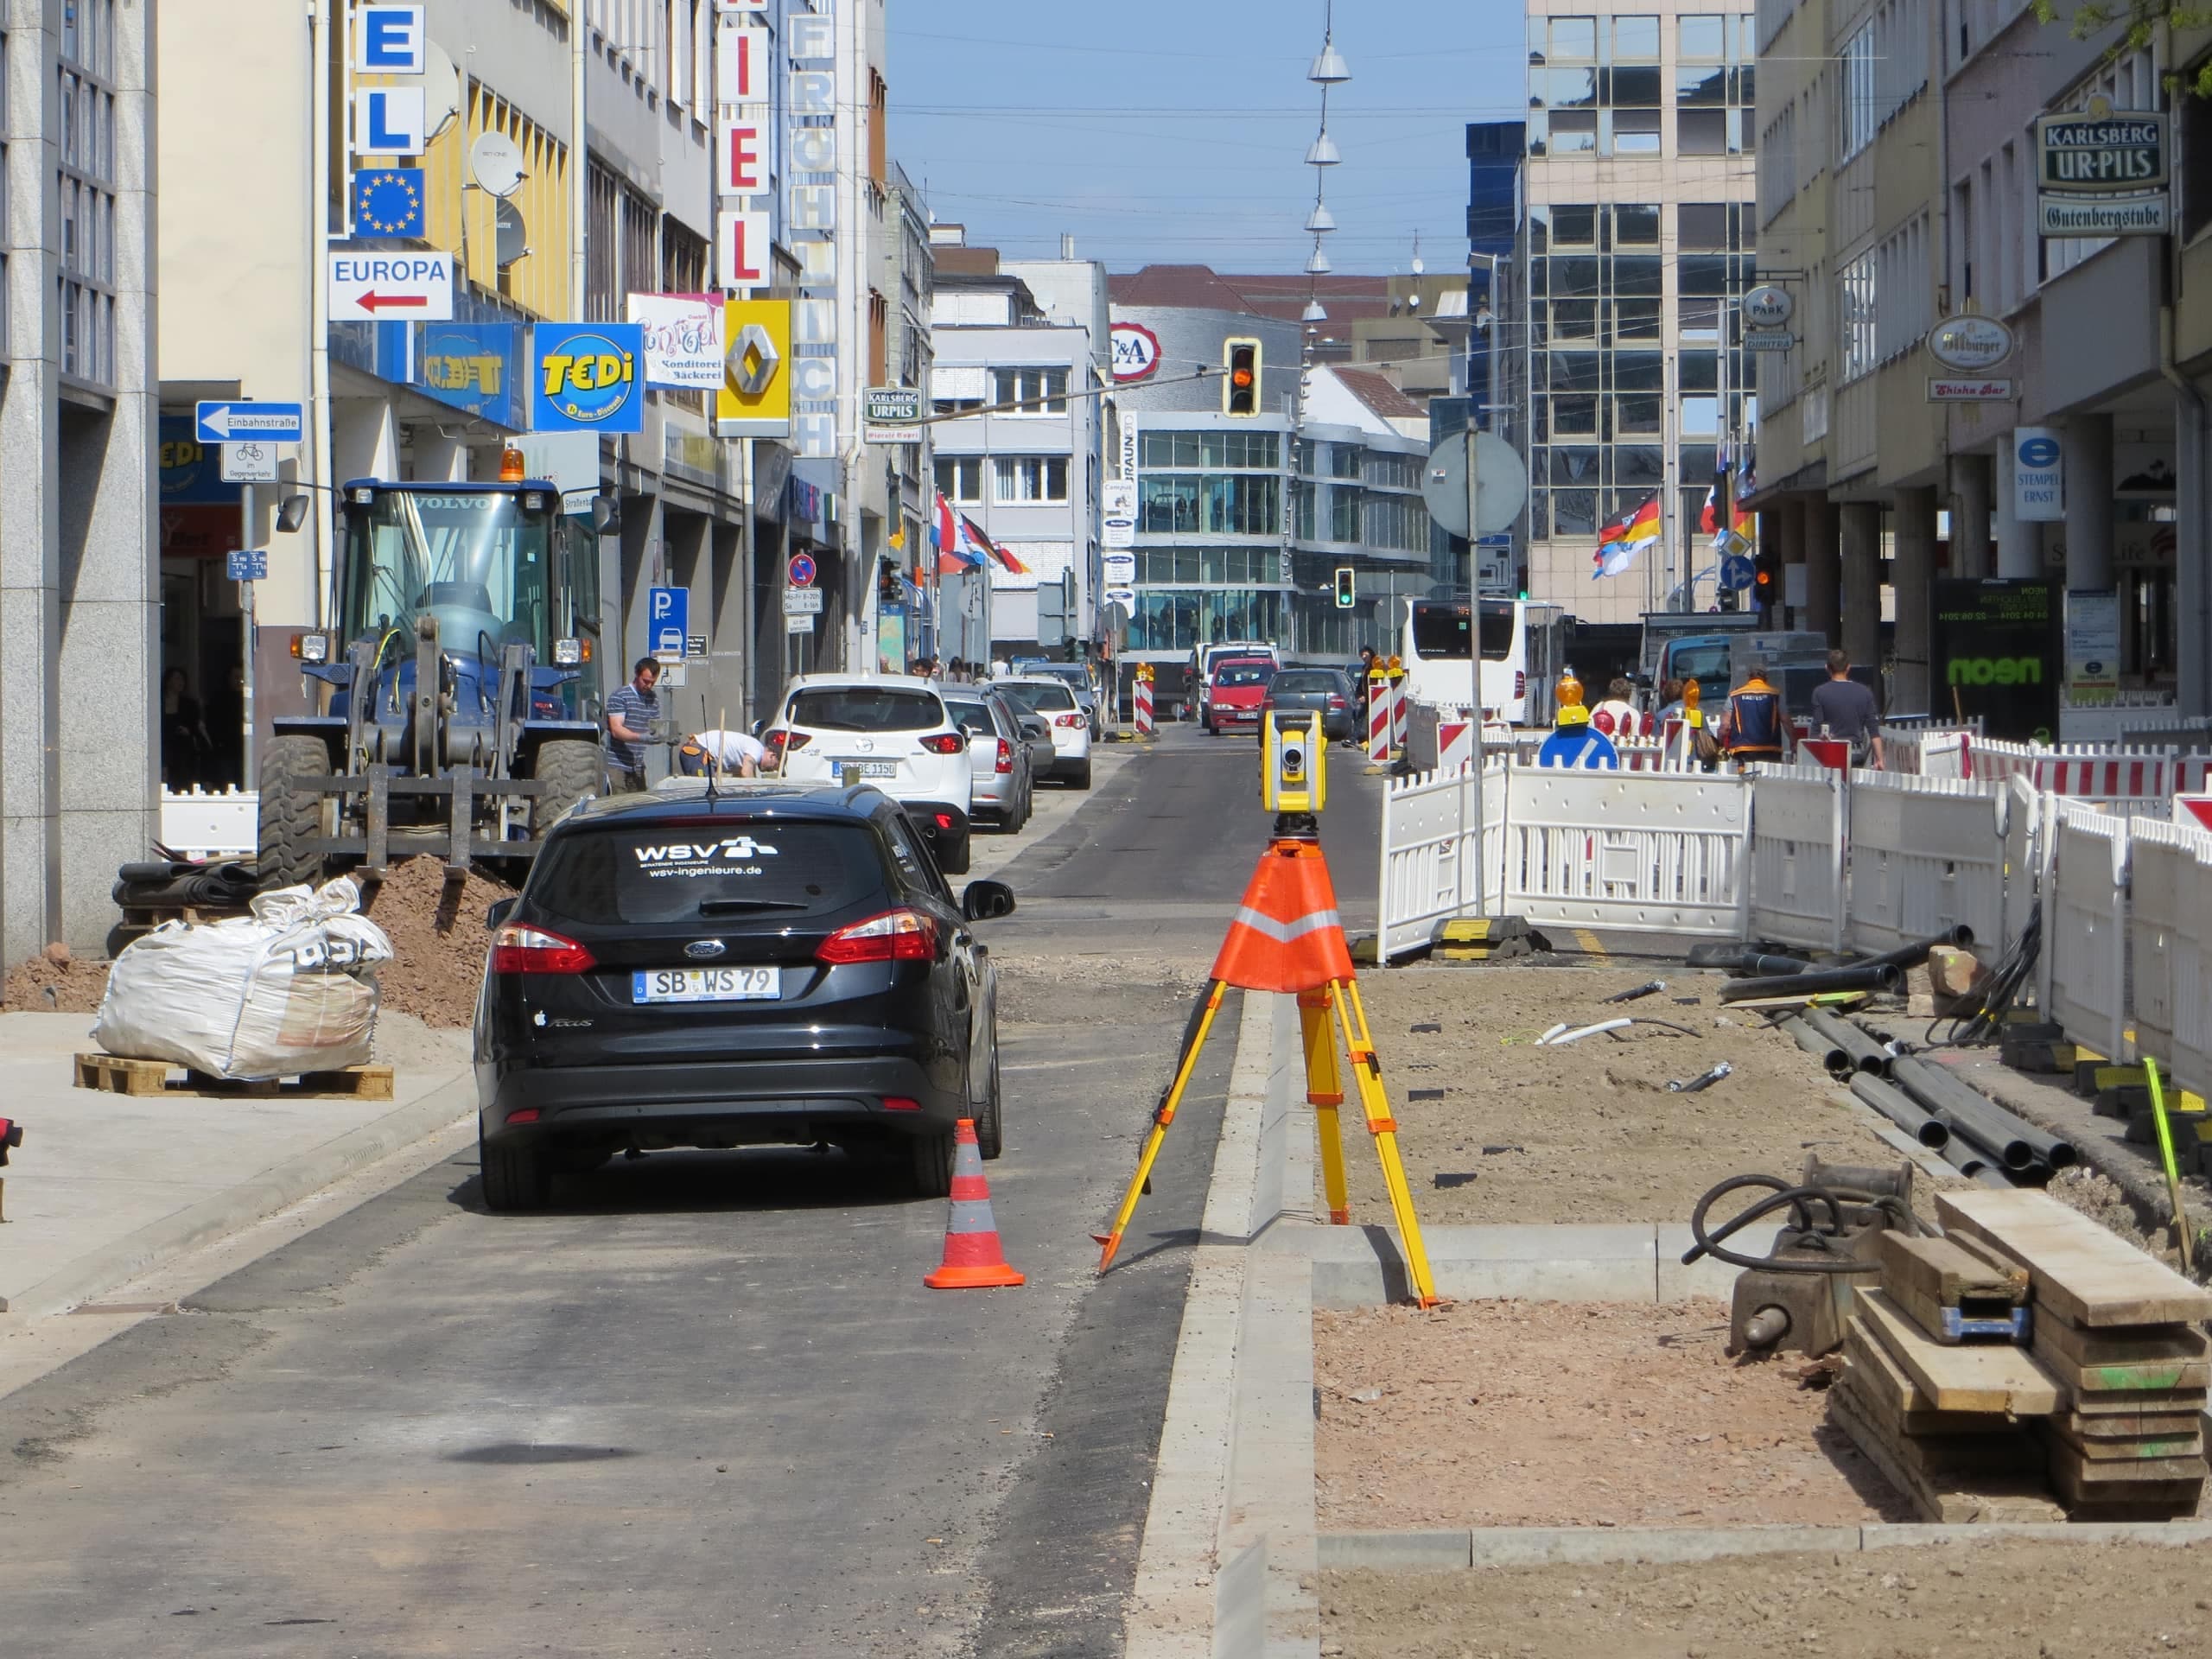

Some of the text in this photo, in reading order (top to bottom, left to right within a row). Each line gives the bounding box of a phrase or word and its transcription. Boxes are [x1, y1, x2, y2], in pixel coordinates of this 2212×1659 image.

[2047, 124, 2158, 145] KARLSBERG
[2046, 205, 2159, 232] Gutenbergstube
[793, 17, 835, 455] FRÖHLICH
[334, 260, 446, 283] EUROPA
[1752, 304, 1784, 315] PARK
[868, 392, 918, 404] KARLSBERG
[227, 417, 297, 428] Einbahnstraße
[229, 470, 271, 479] Gegenverkehr
[2018, 474, 2060, 486] STEMPEL
[416, 497, 492, 510] VOLVO
[2024, 491, 2054, 503] ERNST
[655, 592, 671, 620] P
[635, 843, 719, 861] WSV
[649, 866, 762, 878] wsv-ingenieure.de
[657, 971, 686, 994] SB
[703, 969, 734, 992] WS
[741, 969, 770, 992] 79
